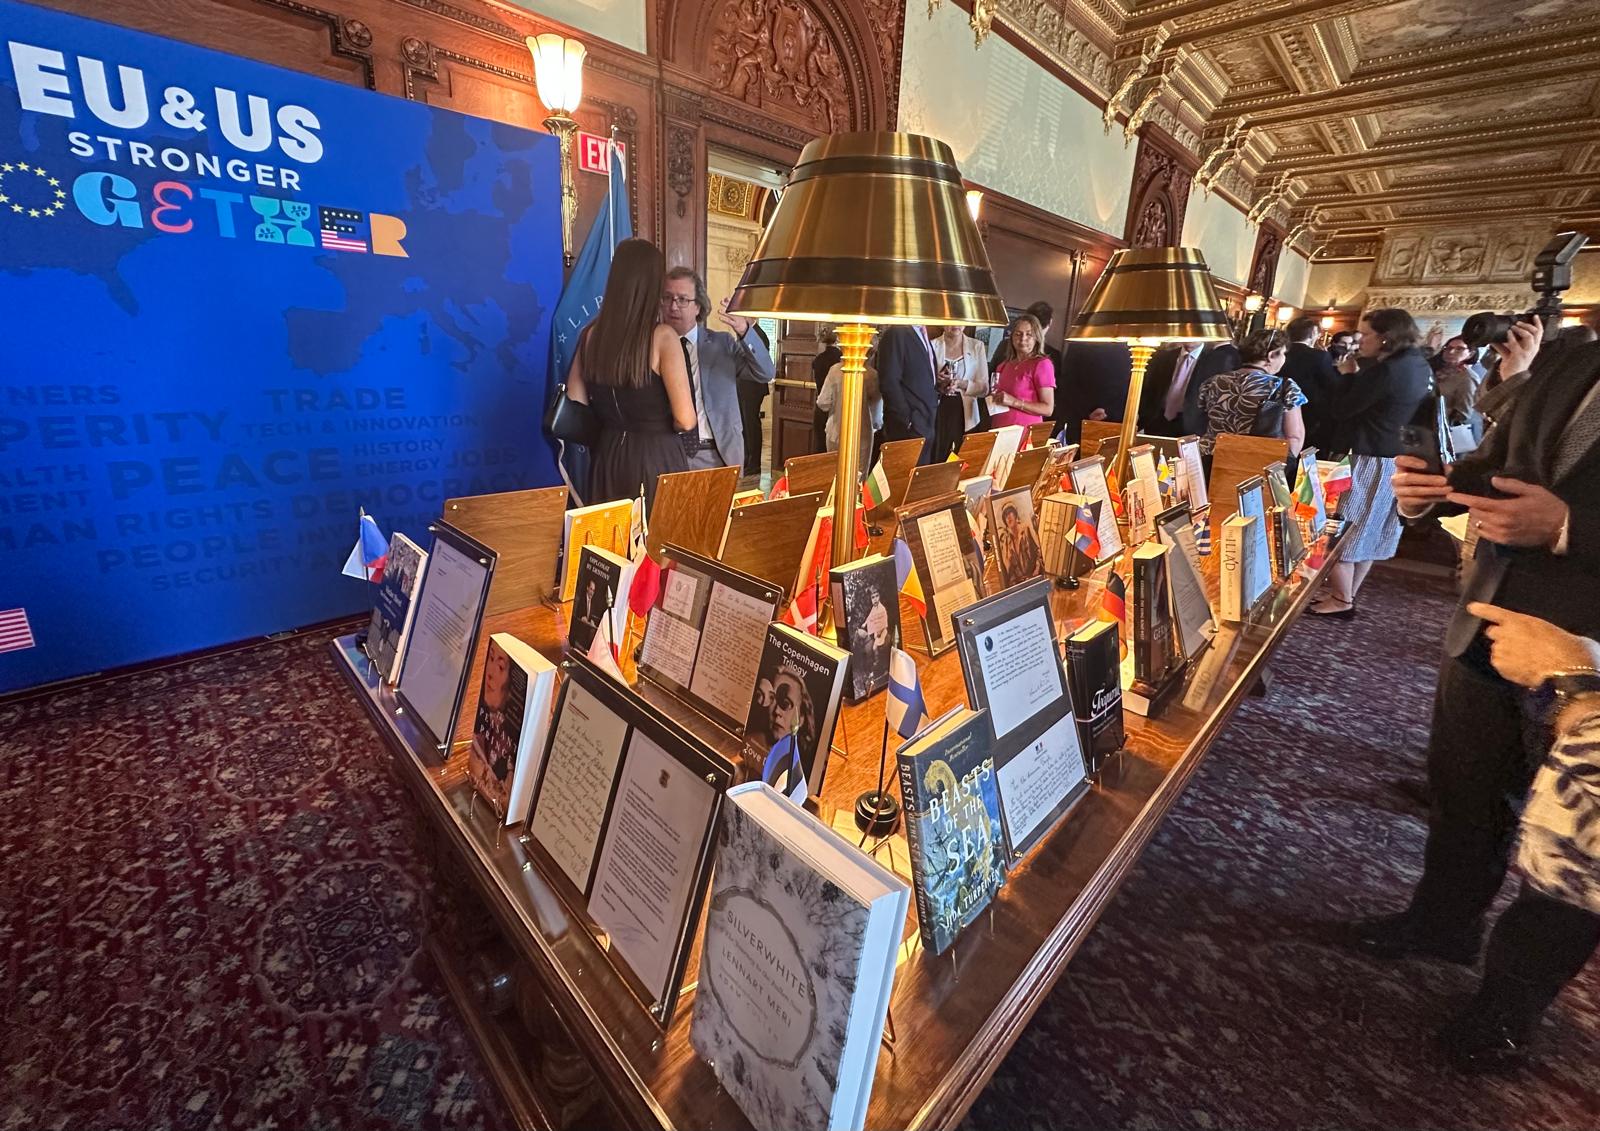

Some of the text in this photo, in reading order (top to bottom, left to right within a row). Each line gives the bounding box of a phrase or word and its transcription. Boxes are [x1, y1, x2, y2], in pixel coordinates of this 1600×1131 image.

[8, 41, 149, 129] EU
[215, 87, 323, 163] US
[68, 131, 301, 191] STRONGER
[587, 137, 616, 173] EX
[263, 387, 407, 413] TRADE
[0, 411, 229, 452] PERITY
[241, 414, 479, 438] TECH & INNOVATION
[353, 438, 446, 456] HISTORY
[355, 458, 440, 477] ENERGY
[446, 447, 519, 469] JOBS
[107, 447, 342, 500] PEACE
[289, 472, 528, 519] DEMOCRACY
[116, 499, 274, 537] RIGHTS
[96, 528, 281, 574] PEOPLE
[1223, 538, 1239, 571] ILIAD
[151, 554, 302, 591] SECURITY
[768, 634, 830, 676] The Copenhagen
[782, 655, 808, 678] Trilogy
[900, 764, 916, 810] BEASTS
[929, 758, 990, 824] BEASTS
[945, 793, 983, 834] OF THE
[947, 814, 988, 873] SEA
[964, 868, 1000, 909] TURPEINEN
[727, 910, 805, 998] SILVERWHITE
[722, 946, 764, 995] LENNART
[767, 994, 792, 1028] MERI
